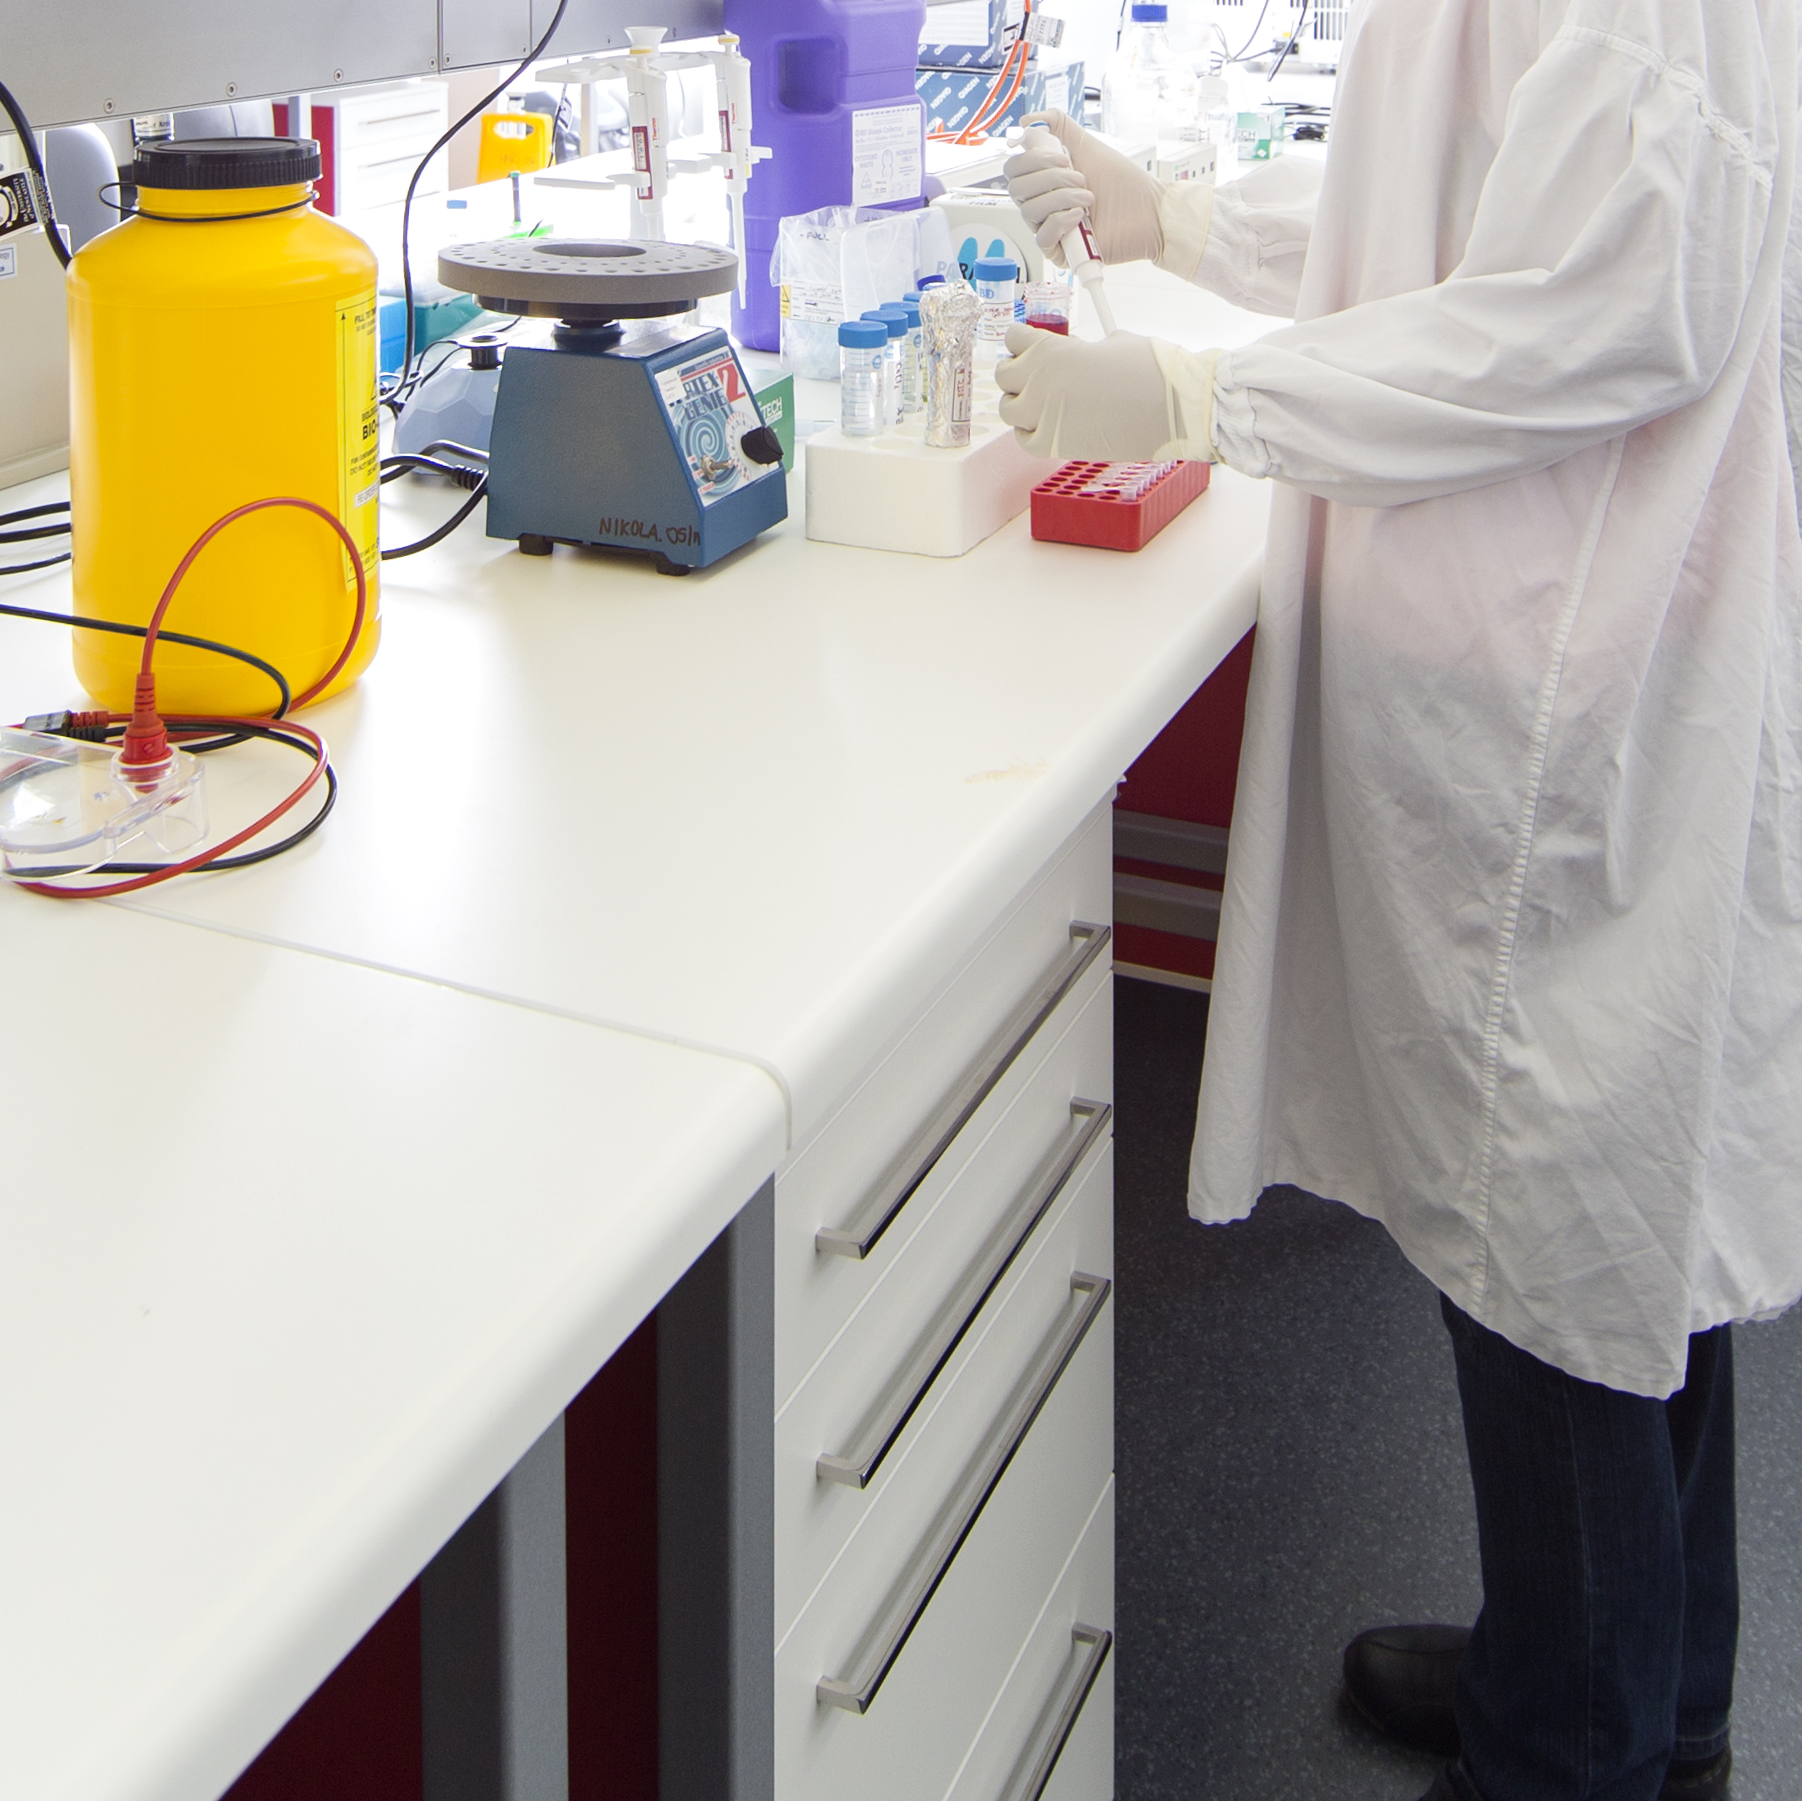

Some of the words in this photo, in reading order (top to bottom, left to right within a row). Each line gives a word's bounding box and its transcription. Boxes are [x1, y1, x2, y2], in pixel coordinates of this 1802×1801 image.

[959, 76, 980, 99] QIAGEN
[683, 371, 720, 400] RTEX
[717, 363, 746, 403] 2
[684, 389, 729, 422] GENIE
[762, 396, 783, 418] TECH
